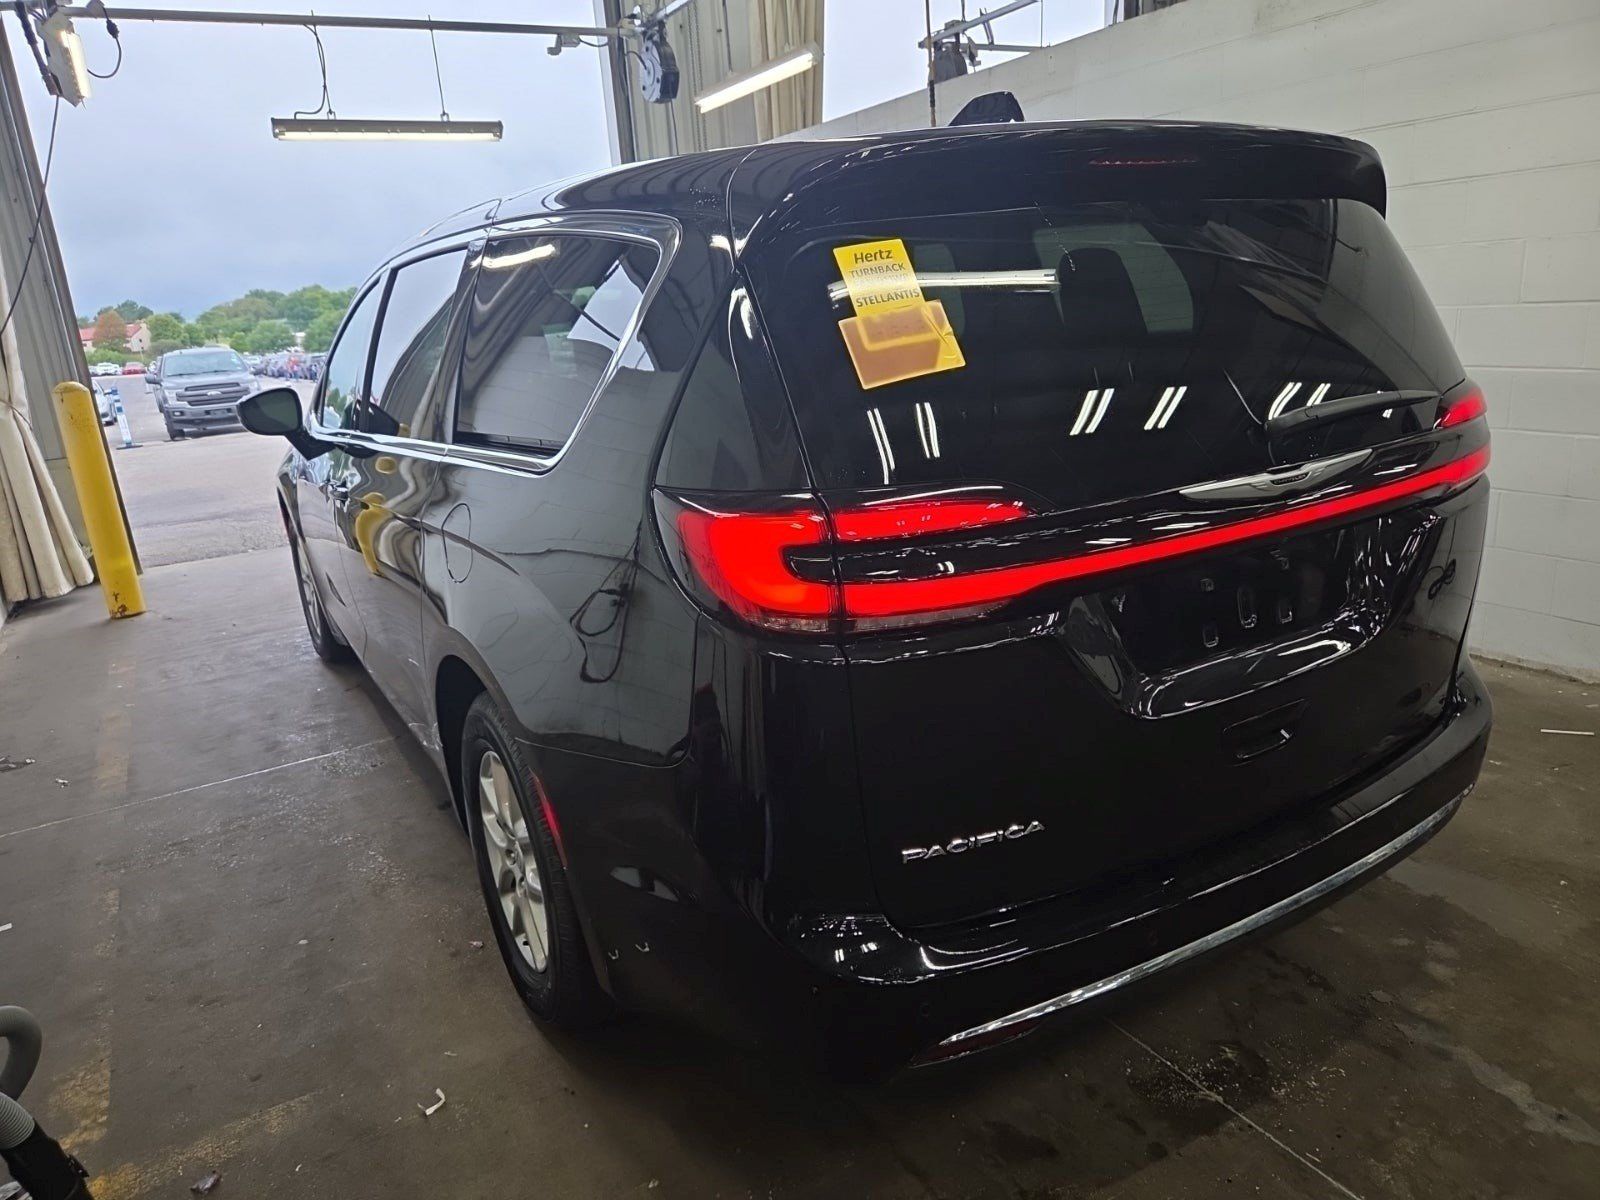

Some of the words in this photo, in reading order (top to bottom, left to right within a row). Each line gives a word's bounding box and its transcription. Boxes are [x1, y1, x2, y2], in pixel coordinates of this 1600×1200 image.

[854, 249, 893, 264] Hertz
[849, 263, 906, 279] TURNBACK
[856, 288, 920, 307] STELLANTIS
[901, 820, 1046, 865] PACIFICA
